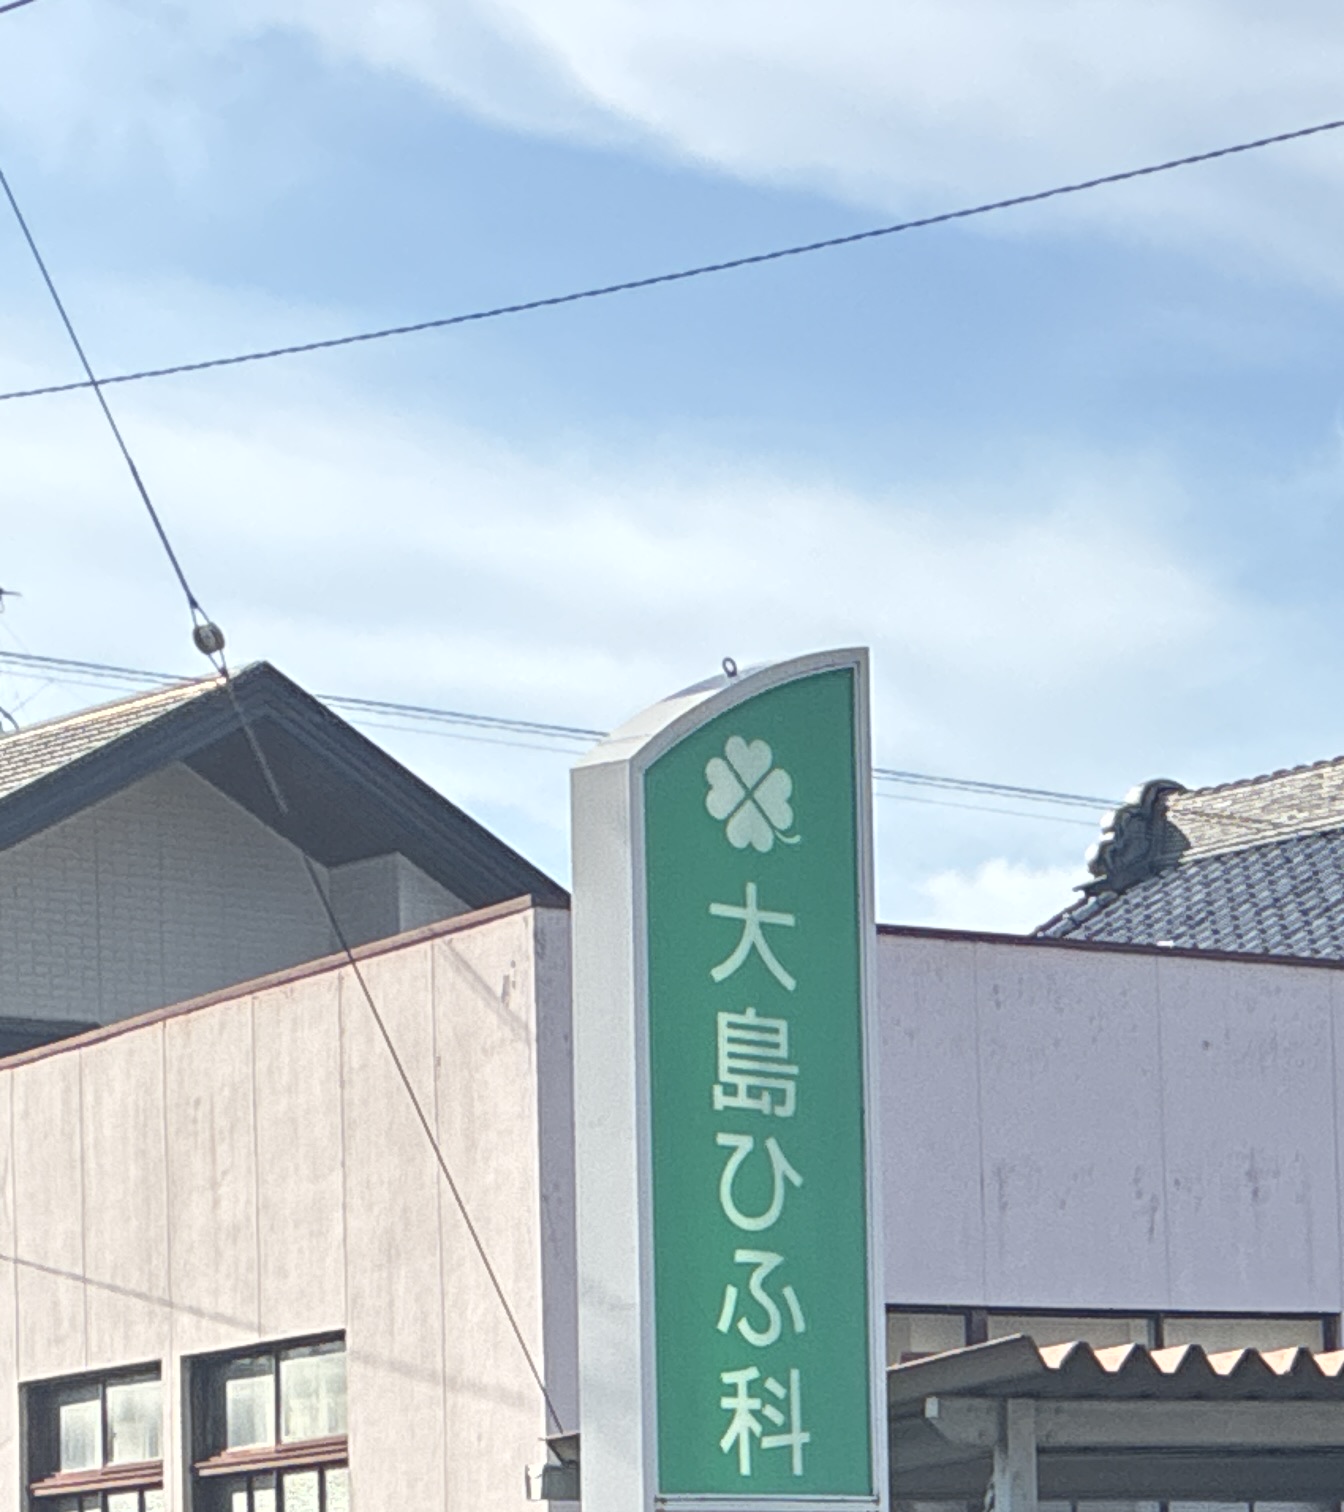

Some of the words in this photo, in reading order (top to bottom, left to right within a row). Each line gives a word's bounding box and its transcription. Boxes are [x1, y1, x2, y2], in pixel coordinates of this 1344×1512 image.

[708, 882, 811, 1477] 大島ひふ科
